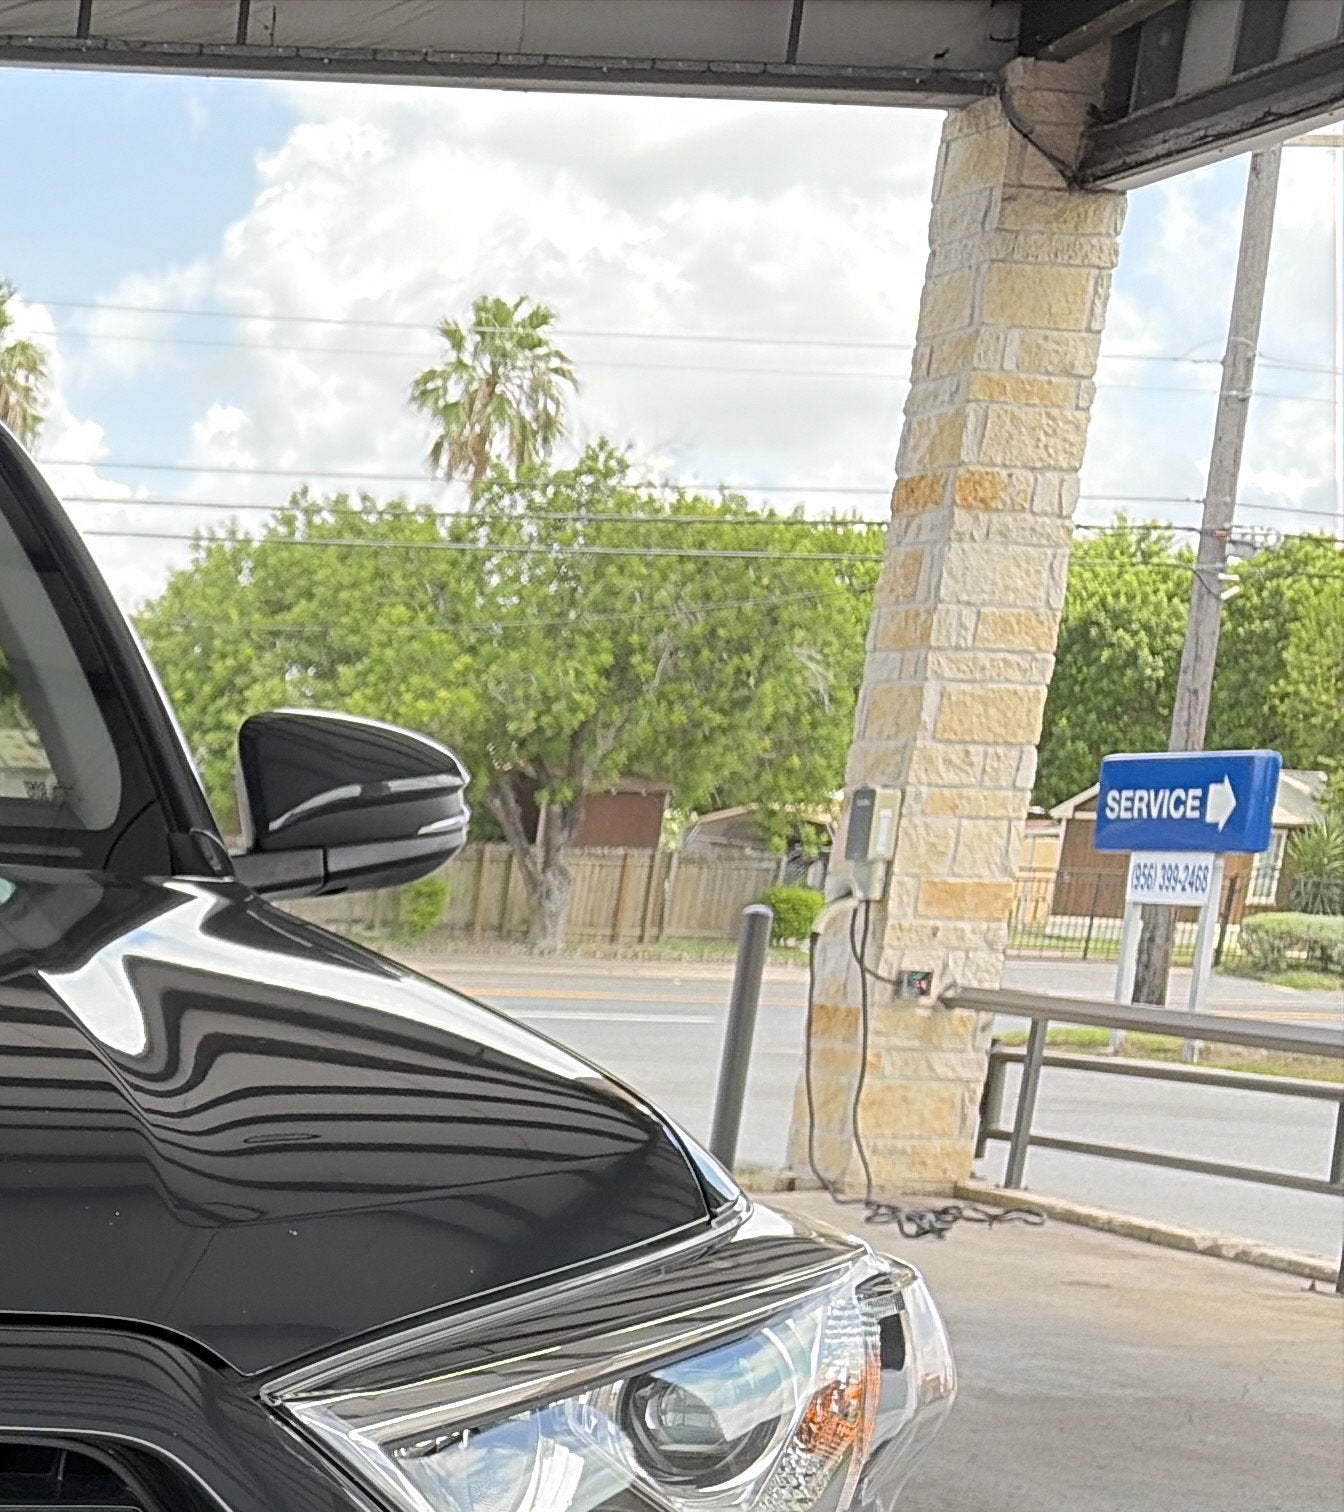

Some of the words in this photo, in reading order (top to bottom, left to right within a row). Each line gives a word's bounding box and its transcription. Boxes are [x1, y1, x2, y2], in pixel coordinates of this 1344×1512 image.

[1105, 788, 1202, 819] SERVICE
[1132, 862, 1157, 892] (956)
[1159, 862, 1209, 894] 399-2468
